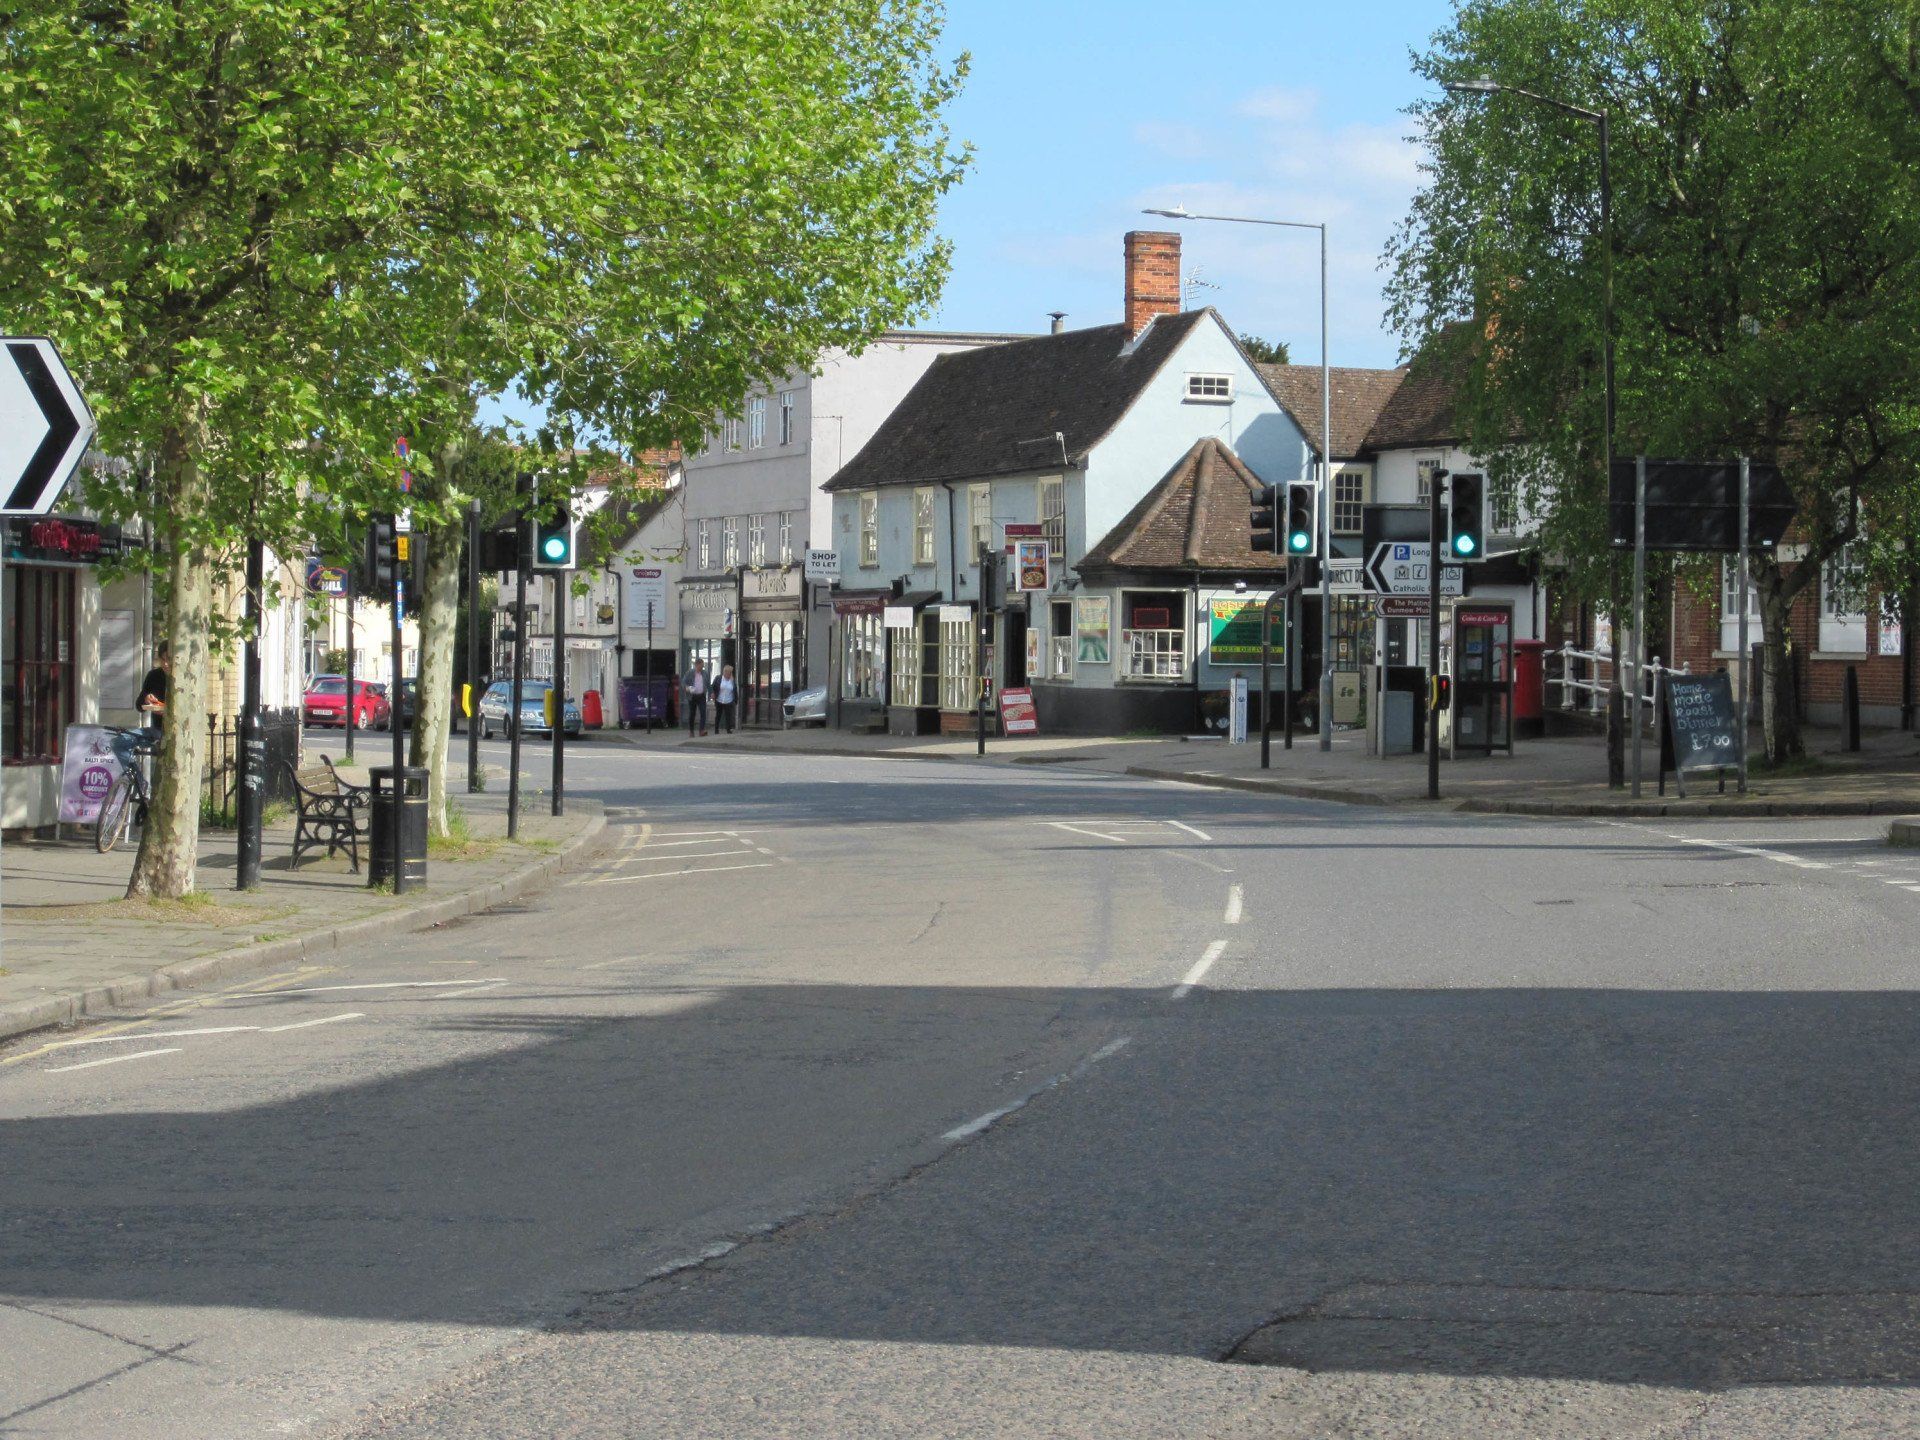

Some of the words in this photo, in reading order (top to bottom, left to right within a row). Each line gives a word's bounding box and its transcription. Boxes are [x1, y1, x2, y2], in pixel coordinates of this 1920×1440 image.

[811, 552, 837, 560] SHOP
[1412, 548, 1430, 557] Long
[1393, 584, 1425, 592] Catholic
[1674, 694, 1711, 707] made
[84, 771, 109, 785] 10%
